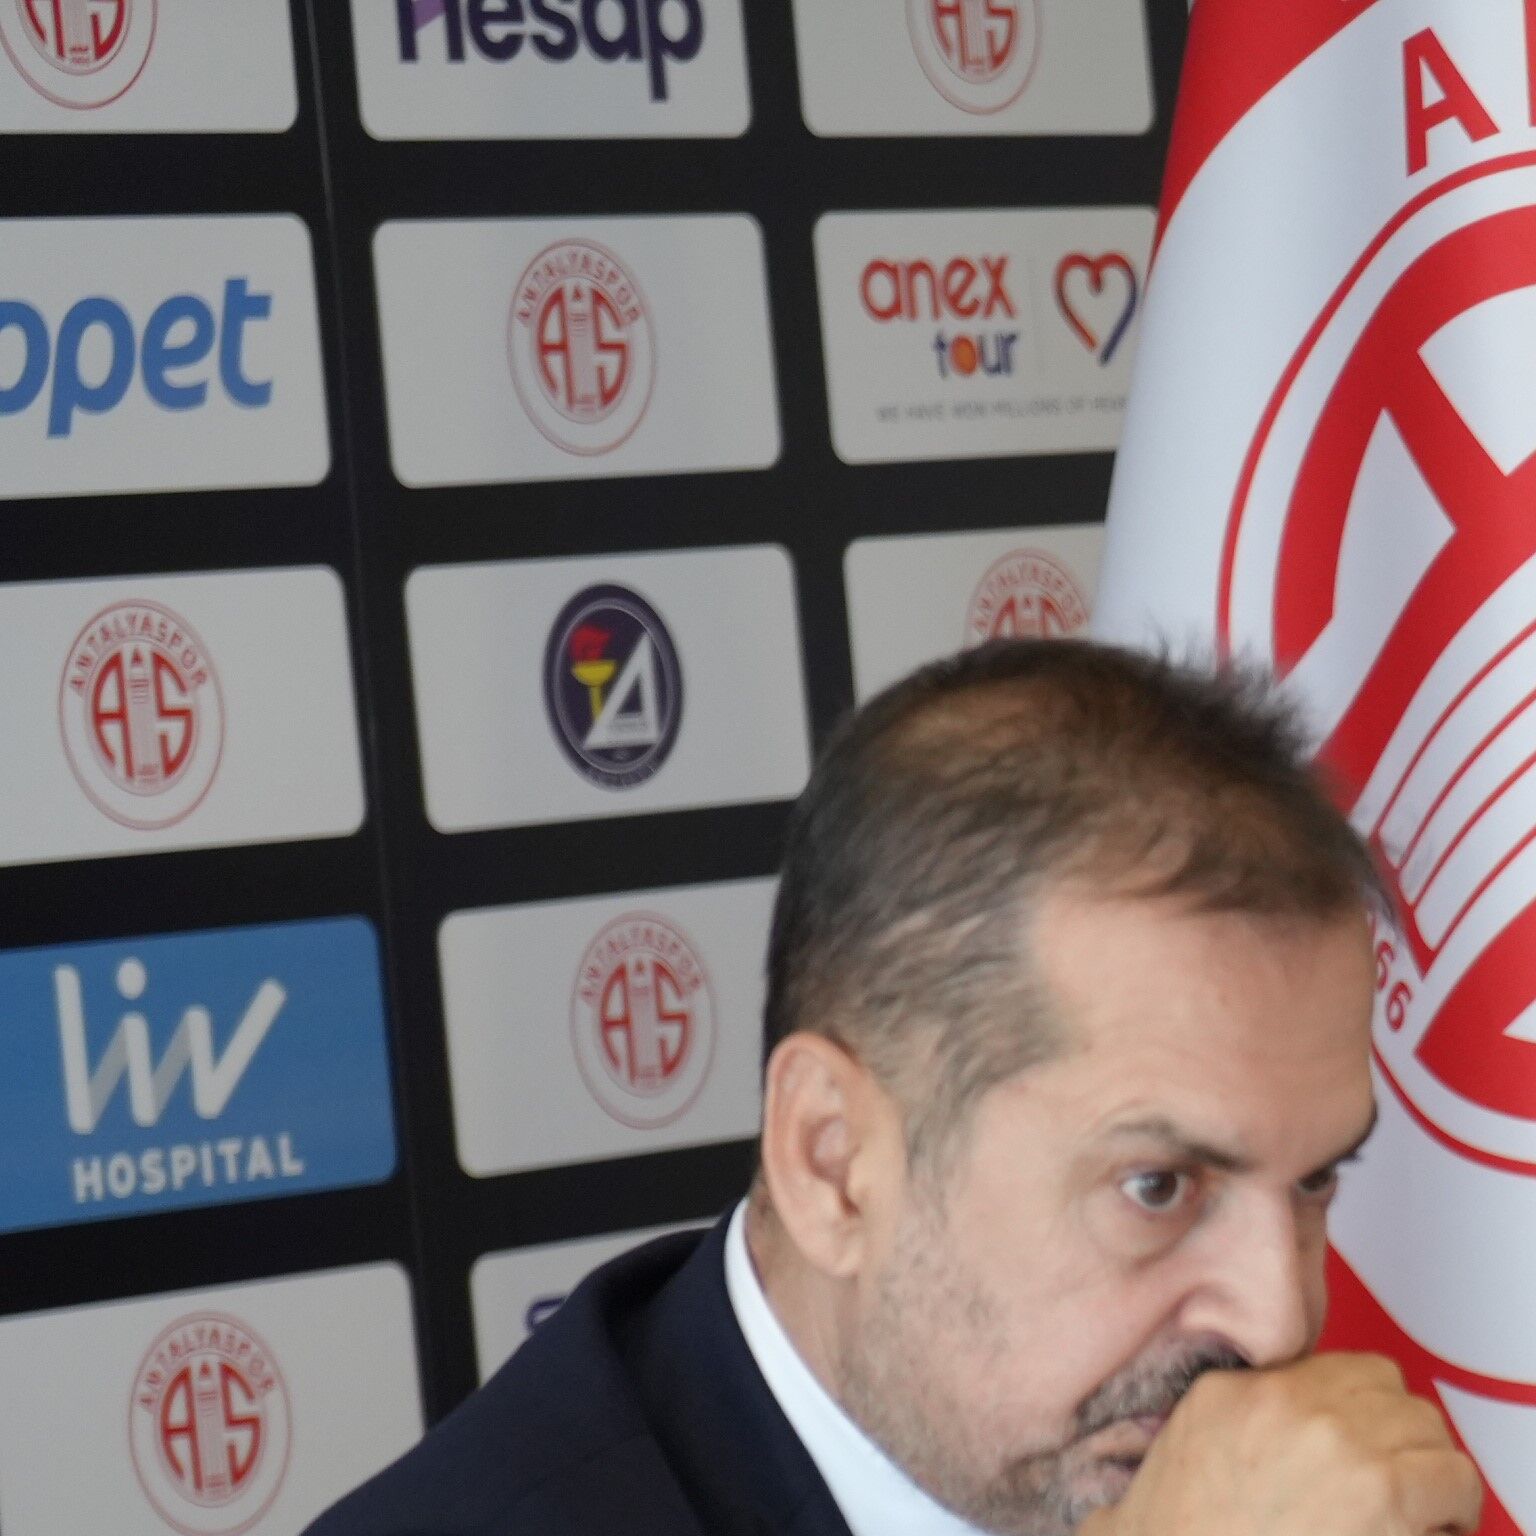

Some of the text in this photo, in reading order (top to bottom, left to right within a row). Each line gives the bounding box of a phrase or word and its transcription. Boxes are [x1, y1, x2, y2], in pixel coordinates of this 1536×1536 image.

[859, 255, 1018, 324] anex
[932, 330, 1019, 380] tour
[72, 1131, 304, 1203] HOSPITAL
